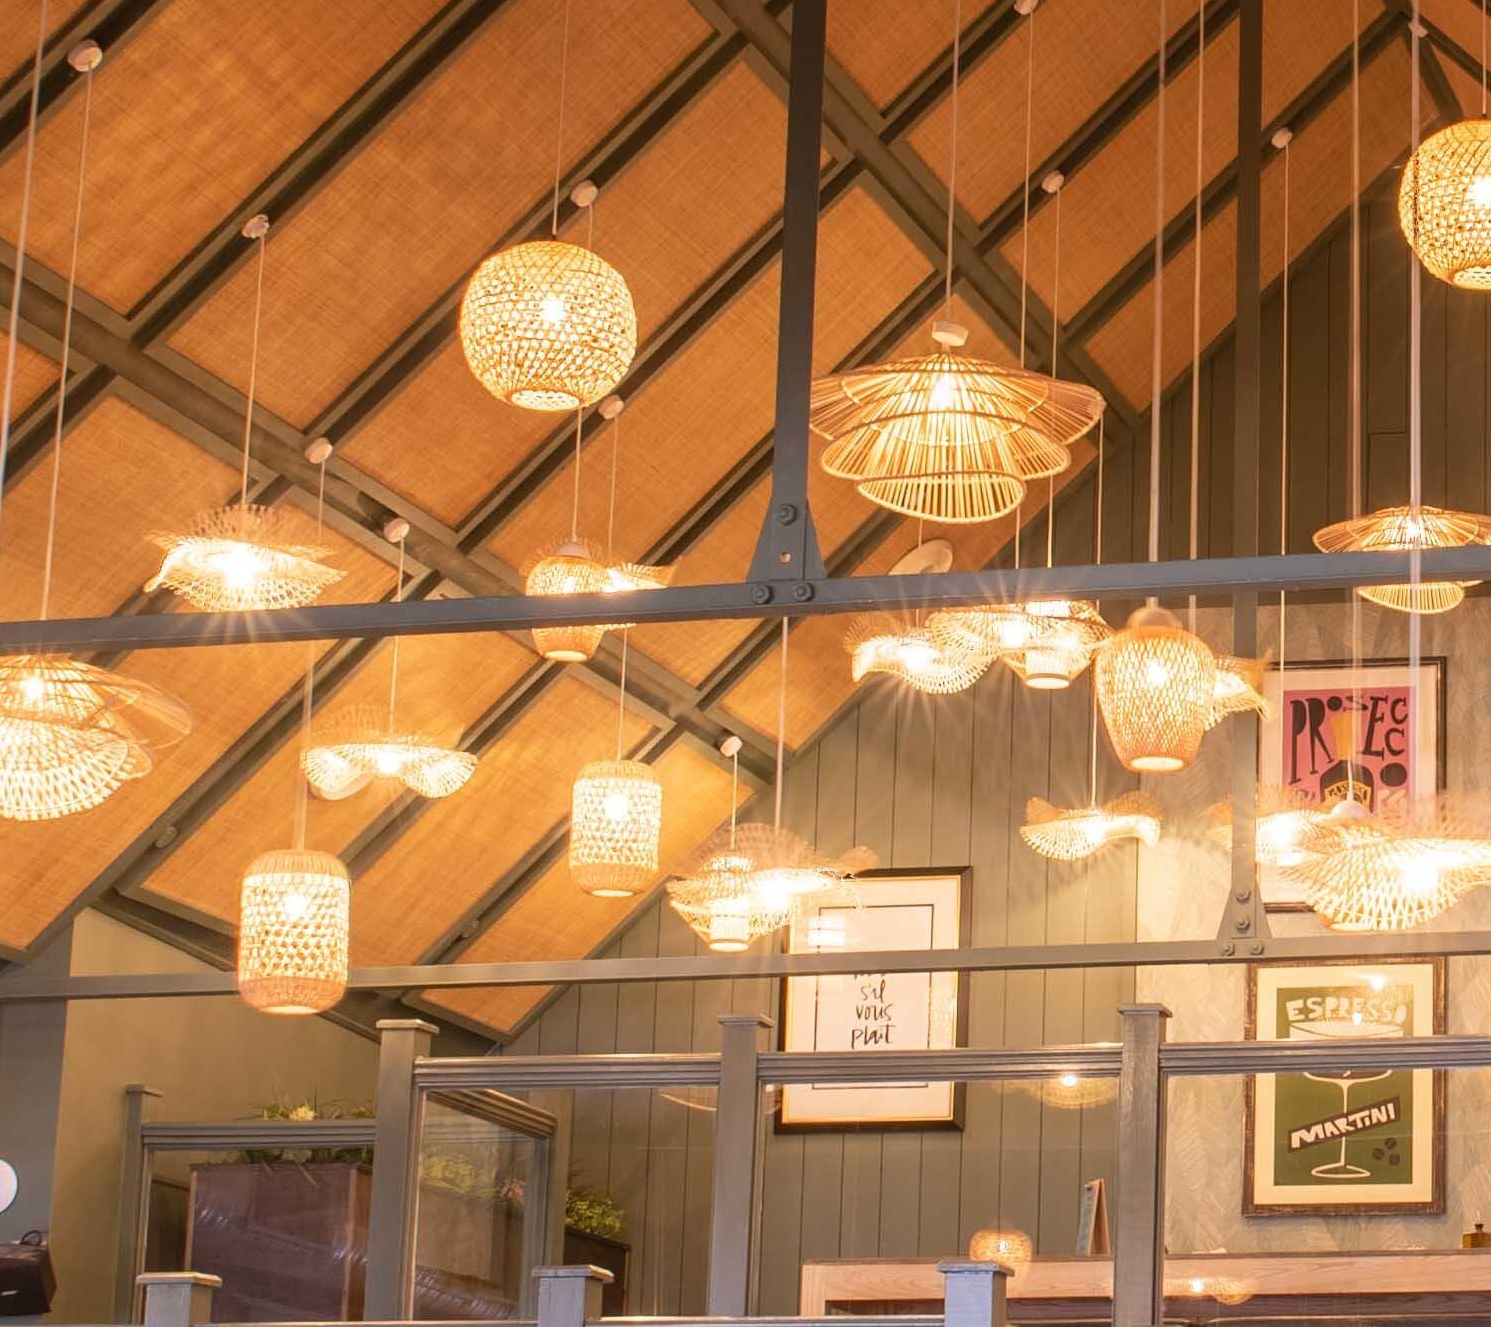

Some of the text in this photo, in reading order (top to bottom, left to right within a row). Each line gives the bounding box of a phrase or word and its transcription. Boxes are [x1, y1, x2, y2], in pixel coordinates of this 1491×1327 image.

[856, 1004, 894, 1022] vous
[1286, 997, 1408, 1024] ESPRESSO
[1291, 1103, 1397, 1149] MARTINI
